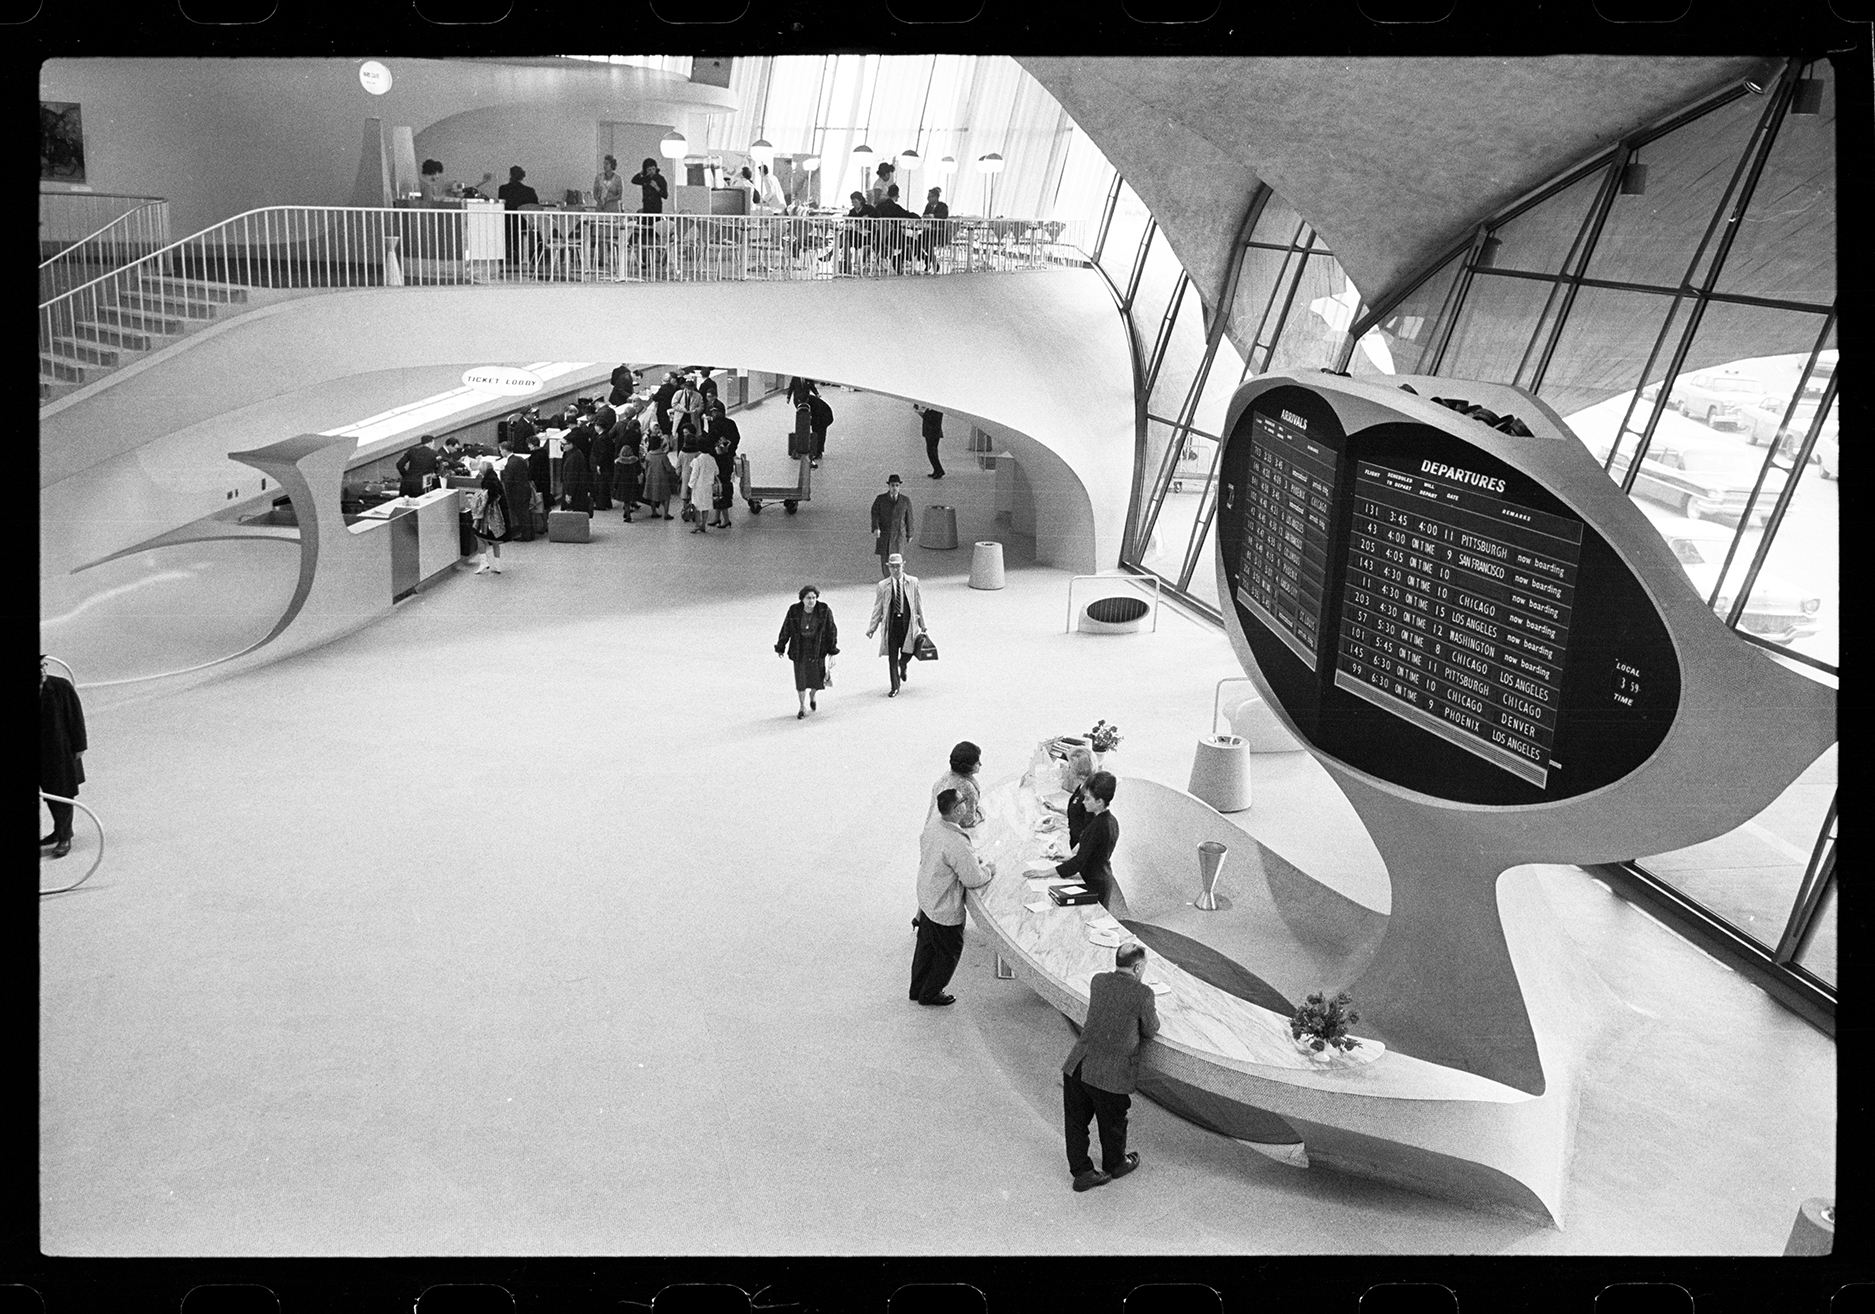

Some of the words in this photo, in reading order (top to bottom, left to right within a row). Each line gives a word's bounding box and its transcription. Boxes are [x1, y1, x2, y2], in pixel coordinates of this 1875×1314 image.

[467, 376, 500, 384] TICKET
[1280, 409, 1308, 430] ARRIVALS
[1420, 459, 1507, 494] DEPARTURES
[1502, 509, 1531, 522] REMARKS
[1360, 538, 1375, 553] 205
[1385, 548, 1403, 563] 4:05
[1439, 567, 1450, 580] 10
[1512, 595, 1526, 605] now
[1528, 598, 1559, 619] boarding
[1365, 503, 1378, 516] 131
[1390, 511, 1407, 526] 3:45
[1418, 521, 1438, 536] 4:00
[1444, 529, 1454, 541] 11
[1461, 534, 1508, 559] PITTSBURGH
[1517, 554, 1532, 564] now
[1534, 558, 1564, 578] boarding
[1367, 523, 1377, 534] 43
[1387, 530, 1406, 544] 4:00
[1447, 549, 1452, 560] 9
[1514, 575, 1529, 585] now
[1531, 578, 1562, 599] boarding
[1355, 591, 1369, 606] 203
[1379, 602, 1397, 617] 4:30
[1433, 624, 1443, 636] 12
[1449, 630, 1495, 657] WASHINGTON
[1504, 654, 1518, 664] now
[1520, 658, 1550, 680] boarding
[1359, 557, 1373, 570] 143
[1383, 567, 1402, 581] 4:30
[1437, 586, 1448, 599] 10
[1459, 594, 1496, 616] CHICAGO
[1509, 614, 1523, 624] now
[1526, 619, 1556, 639] boarding
[1362, 576, 1371, 588] 11
[1381, 585, 1400, 599] 4:30
[1435, 605, 1445, 617] 15
[1452, 611, 1464, 625] LOS
[1465, 617, 1497, 638] ANGELES
[1506, 634, 1521, 644] now
[1523, 638, 1553, 660] boarding
[1350, 644, 1363, 658] 145
[1373, 655, 1391, 670] 6:30
[1426, 679, 1436, 691] 10
[1447, 688, 1482, 713] CHICAGO
[1501, 713, 1535, 737] DENVER
[1352, 626, 1365, 640] 101
[1375, 636, 1393, 653] 5:45
[1428, 660, 1437, 672] 11
[1444, 667, 1489, 696] PITTSBURGH
[1502, 693, 1541, 719] CHICAGO
[1358, 610, 1367, 622] 57
[1377, 619, 1395, 635] 5:30
[1435, 643, 1441, 654] 8
[1451, 651, 1488, 675] CHICAGO
[1499, 671, 1513, 686] LOS
[1514, 678, 1548, 701] ANGELES
[1616, 662, 1640, 677] LOCAL
[1352, 663, 1362, 675] 99
[1371, 673, 1389, 688] 6:30
[1428, 699, 1434, 709] 9
[1444, 707, 1480, 732] PHOENIX
[1492, 729, 1506, 744] LOS
[1506, 736, 1540, 760] ANGELES
[1613, 692, 1634, 706] TIME
